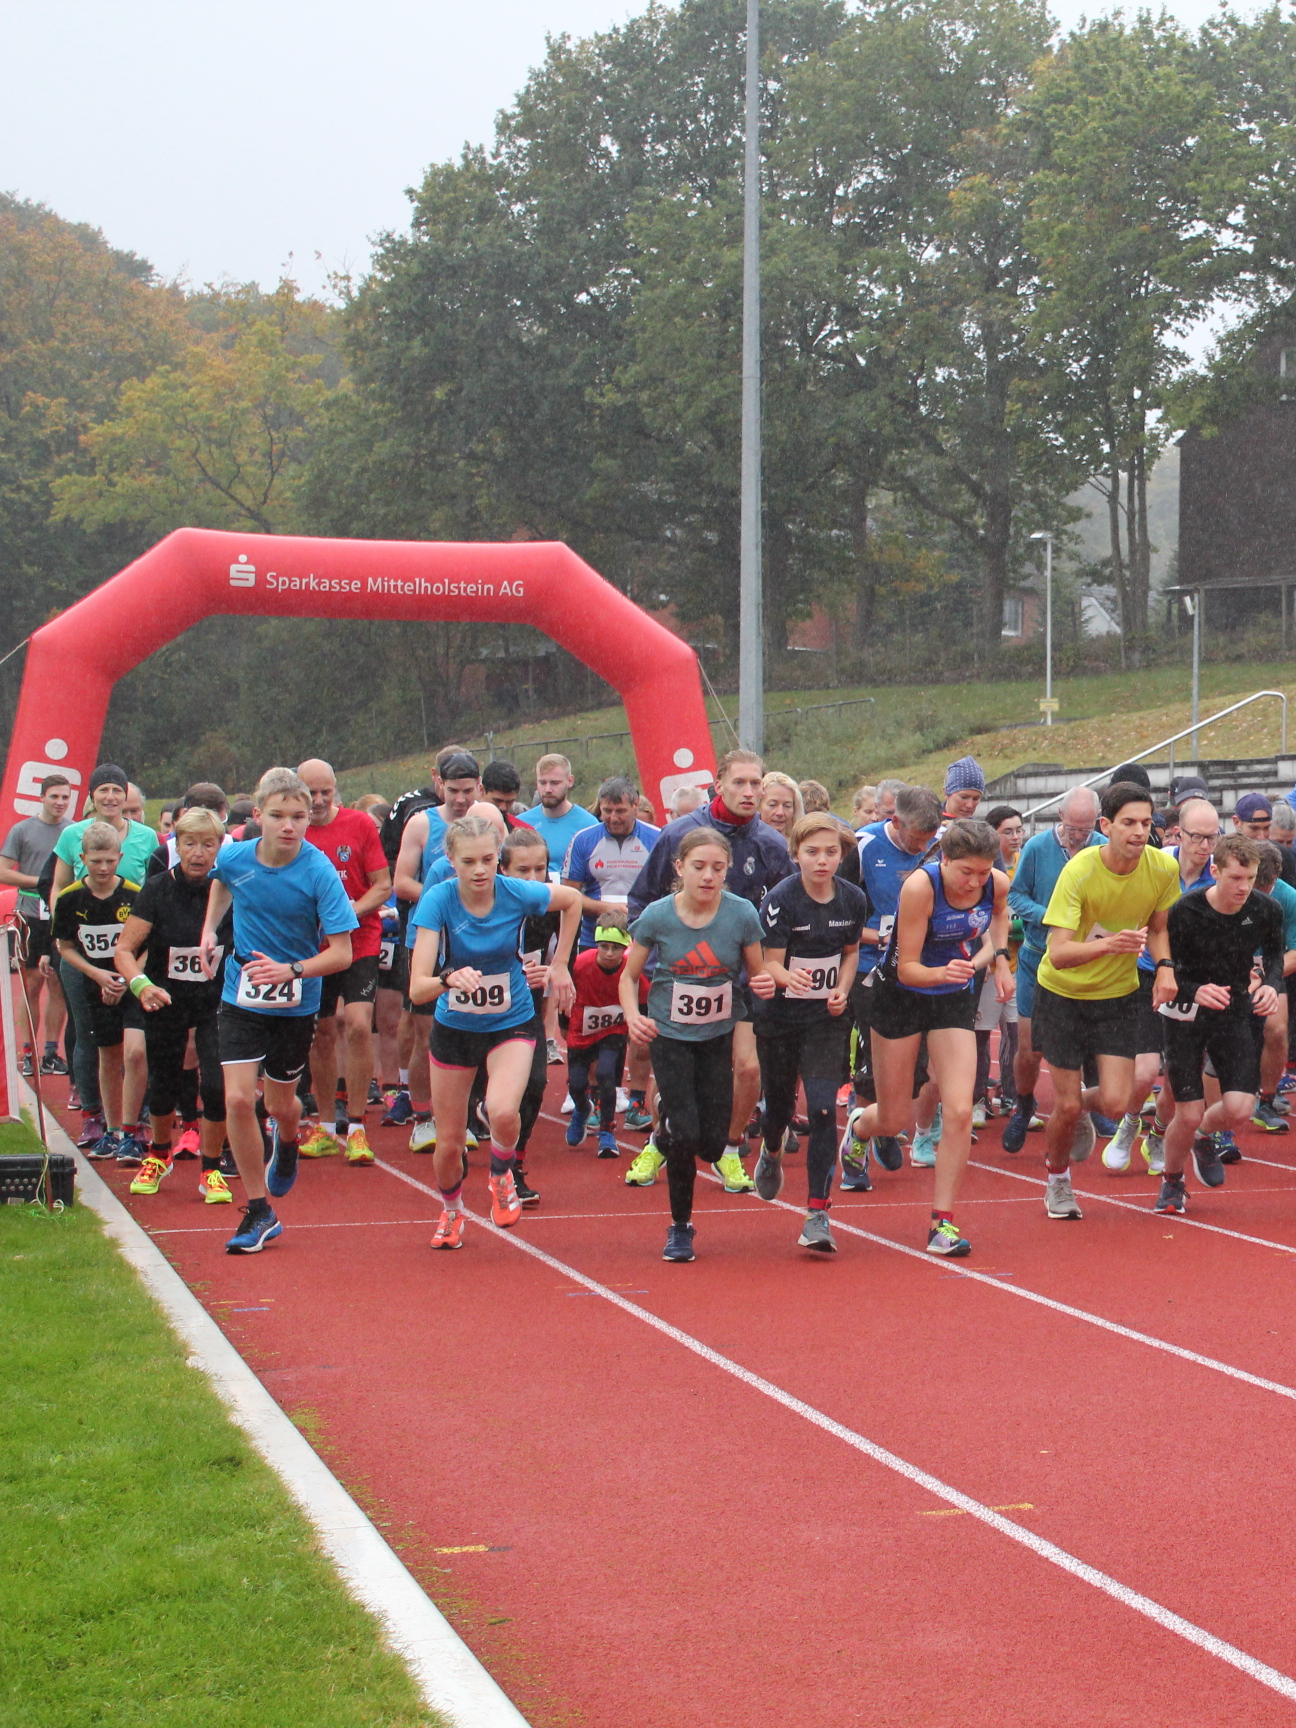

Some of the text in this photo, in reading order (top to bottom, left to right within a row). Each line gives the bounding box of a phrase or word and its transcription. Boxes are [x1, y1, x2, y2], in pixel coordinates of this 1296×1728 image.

[265, 571, 525, 597] Sparkasse Mittelholstein AG
[245, 976, 296, 1002] 324
[803, 966, 838, 991] 90
[455, 984, 504, 1007] 309
[677, 993, 725, 1017] 391
[587, 1012, 625, 1031] 384
